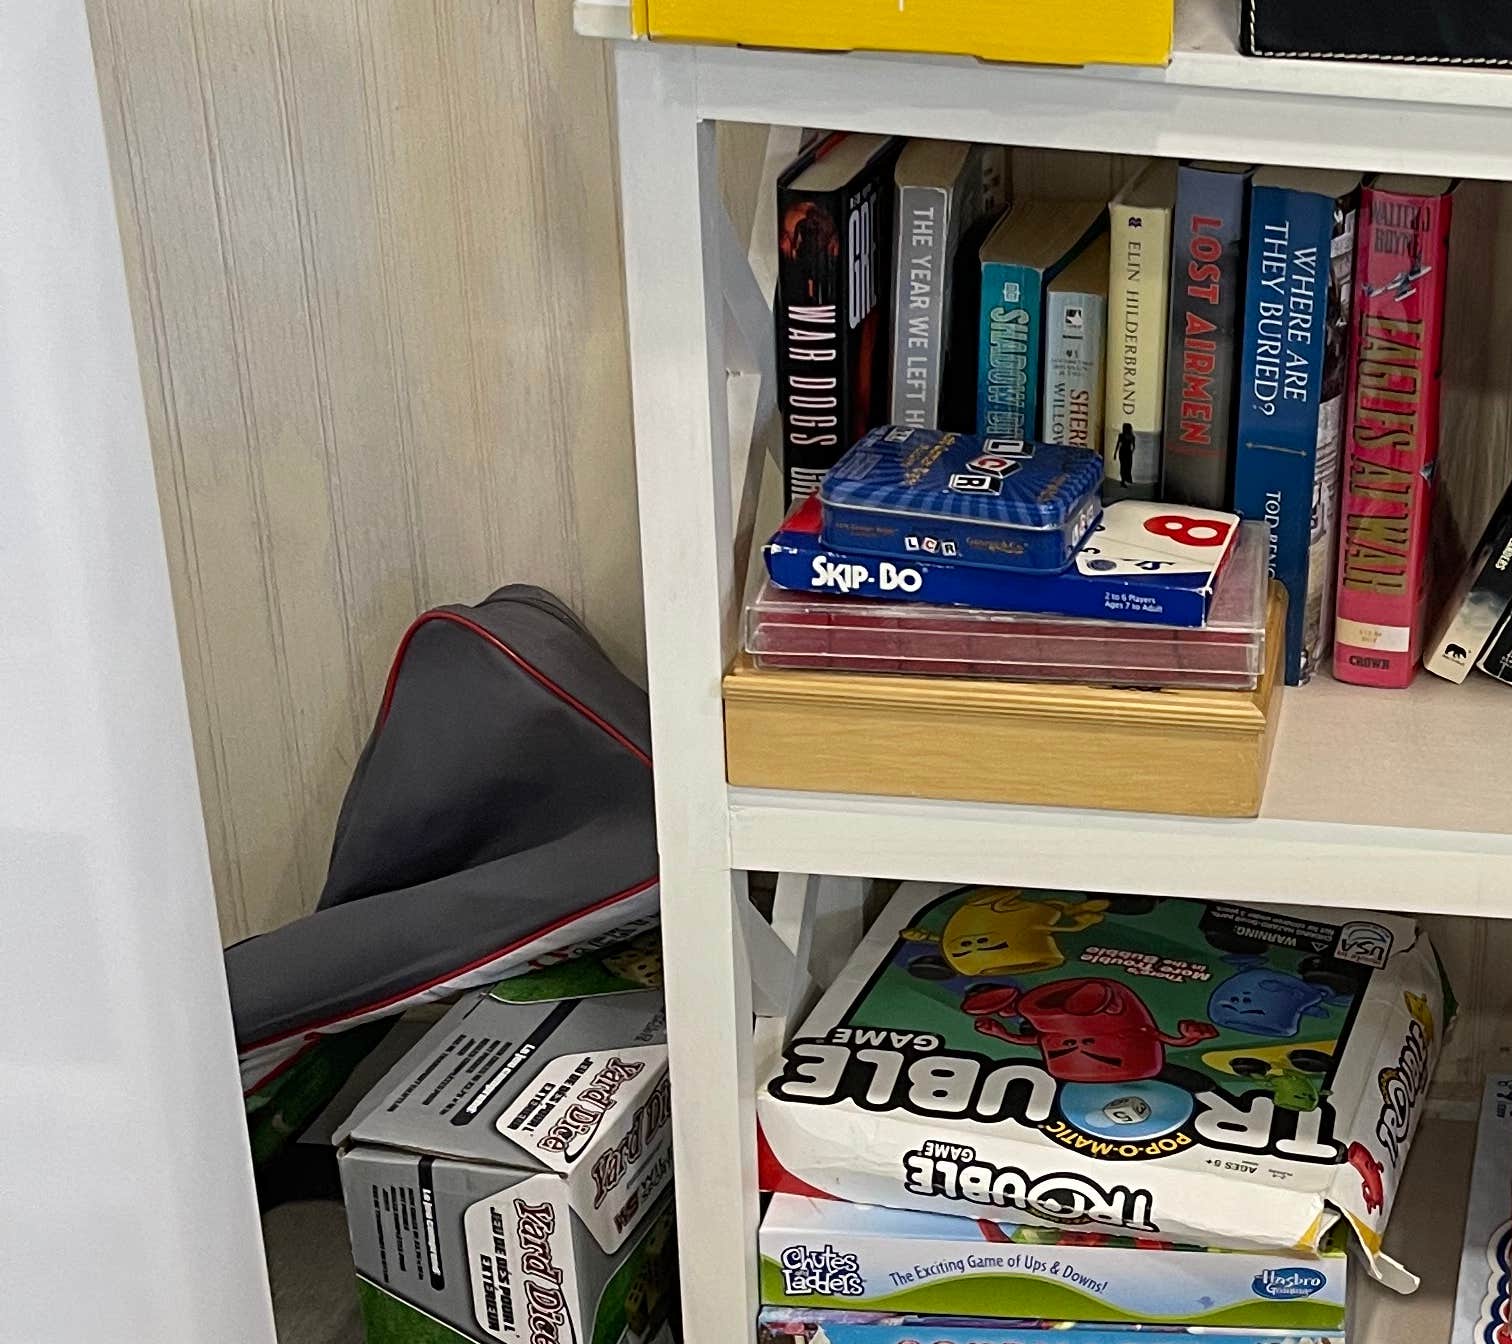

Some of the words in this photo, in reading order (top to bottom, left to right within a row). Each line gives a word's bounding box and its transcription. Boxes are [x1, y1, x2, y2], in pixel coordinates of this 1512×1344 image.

[911, 207, 935, 248] THE
[1127, 240, 1142, 283] ELIN
[1184, 215, 1224, 306] LOST
[1257, 220, 1291, 302] THEY
[909, 255, 933, 310] YEAR
[1286, 246, 1318, 343] WHERE
[788, 305, 836, 361] WAR
[907, 316, 930, 349] WE
[1122, 287, 1141, 416] HILDERBRAND
[987, 306, 1031, 408] SHADOW
[1252, 303, 1284, 417] BURIED?
[1282, 346, 1310, 403] ARE
[905, 356, 929, 404] LEFT
[1178, 312, 1217, 446] AIRMEN
[1351, 312, 1425, 452] EAGLES
[789, 374, 837, 447] DOGS
[1347, 453, 1420, 506] AT
[811, 554, 924, 594] SKIP-BO
[1342, 513, 1414, 598] WAR
[1104, 601, 1124, 611] Ages
[1142, 605, 1163, 614] Adult
[1128, 595, 1157, 605] Players
[1235, 925, 1298, 947] WARNING:
[1340, 937, 1385, 961] USA
[1080, 954, 1160, 972] Trouble
[831, 1028, 941, 1052] GAME
[575, 1056, 594, 1074] JEU
[577, 1057, 646, 1111] Yard
[537, 1104, 600, 1153] Dice
[1040, 1120, 1194, 1158] POP-O-MATIC
[922, 1141, 974, 1160] GAME
[1225, 1161, 1259, 1174] AGES
[908, 1156, 1158, 1232] TROUBLE
[490, 1206, 504, 1238] JEU
[514, 1198, 563, 1285] Yard
[493, 1238, 507, 1259] DE
[781, 1245, 859, 1274] Chutes
[783, 1267, 864, 1297] Ladders
[889, 1269, 911, 1288] The
[913, 1260, 965, 1284] Exciting
[967, 1255, 1004, 1273] Game
[1007, 1255, 1021, 1270] of
[1023, 1255, 1049, 1275] Ups
[1050, 1261, 1061, 1274] &
[1062, 1263, 1109, 1294] Downs!
[1260, 1268, 1322, 1288] Hasbro
